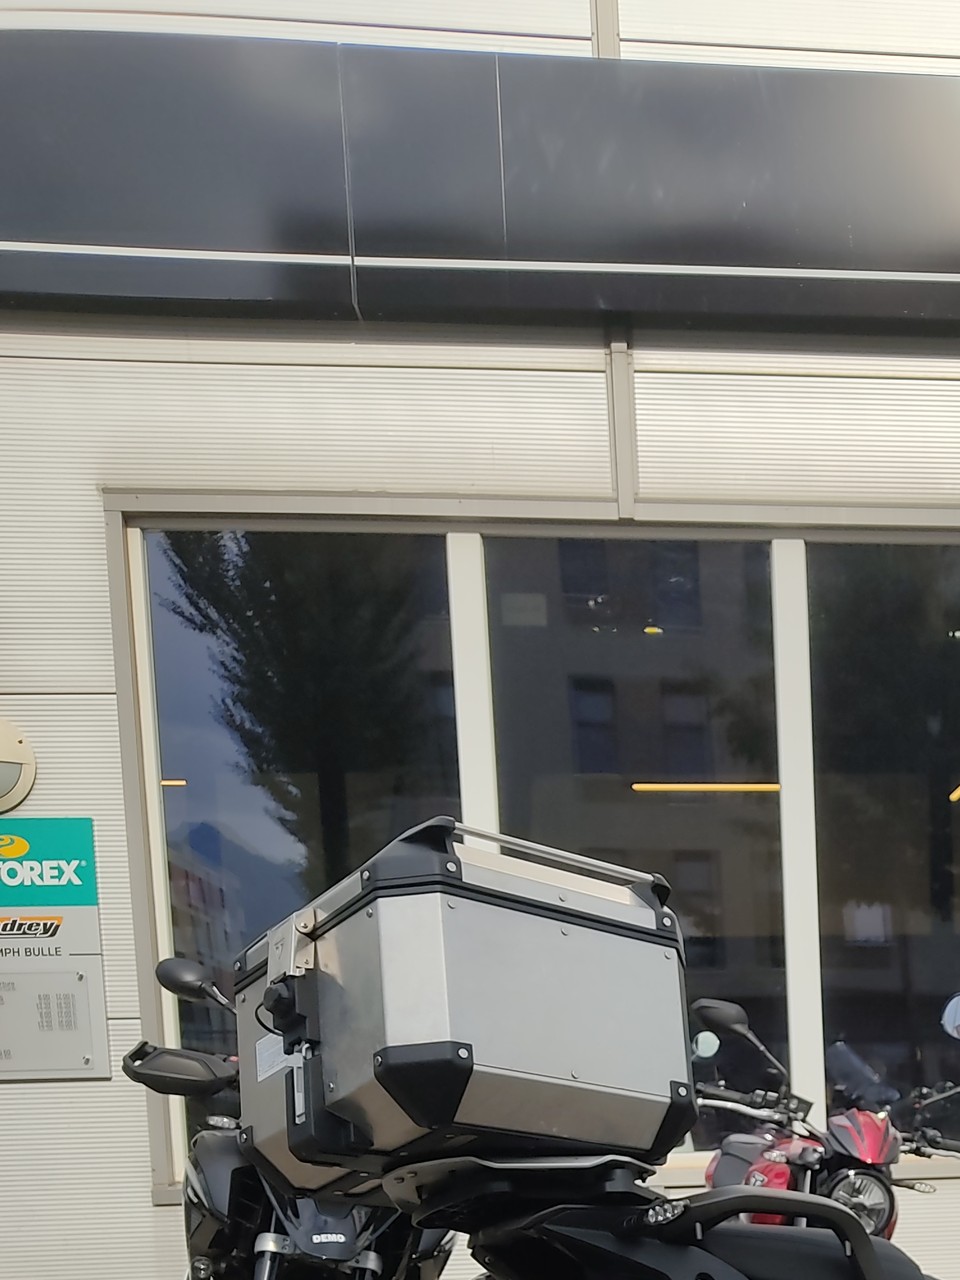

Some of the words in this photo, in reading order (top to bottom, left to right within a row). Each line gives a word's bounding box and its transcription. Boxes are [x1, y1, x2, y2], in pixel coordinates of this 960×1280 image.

[0, 859, 83, 887] OREX
[24, 946, 62, 957] BULLE
[312, 1233, 346, 1244] DEMO
